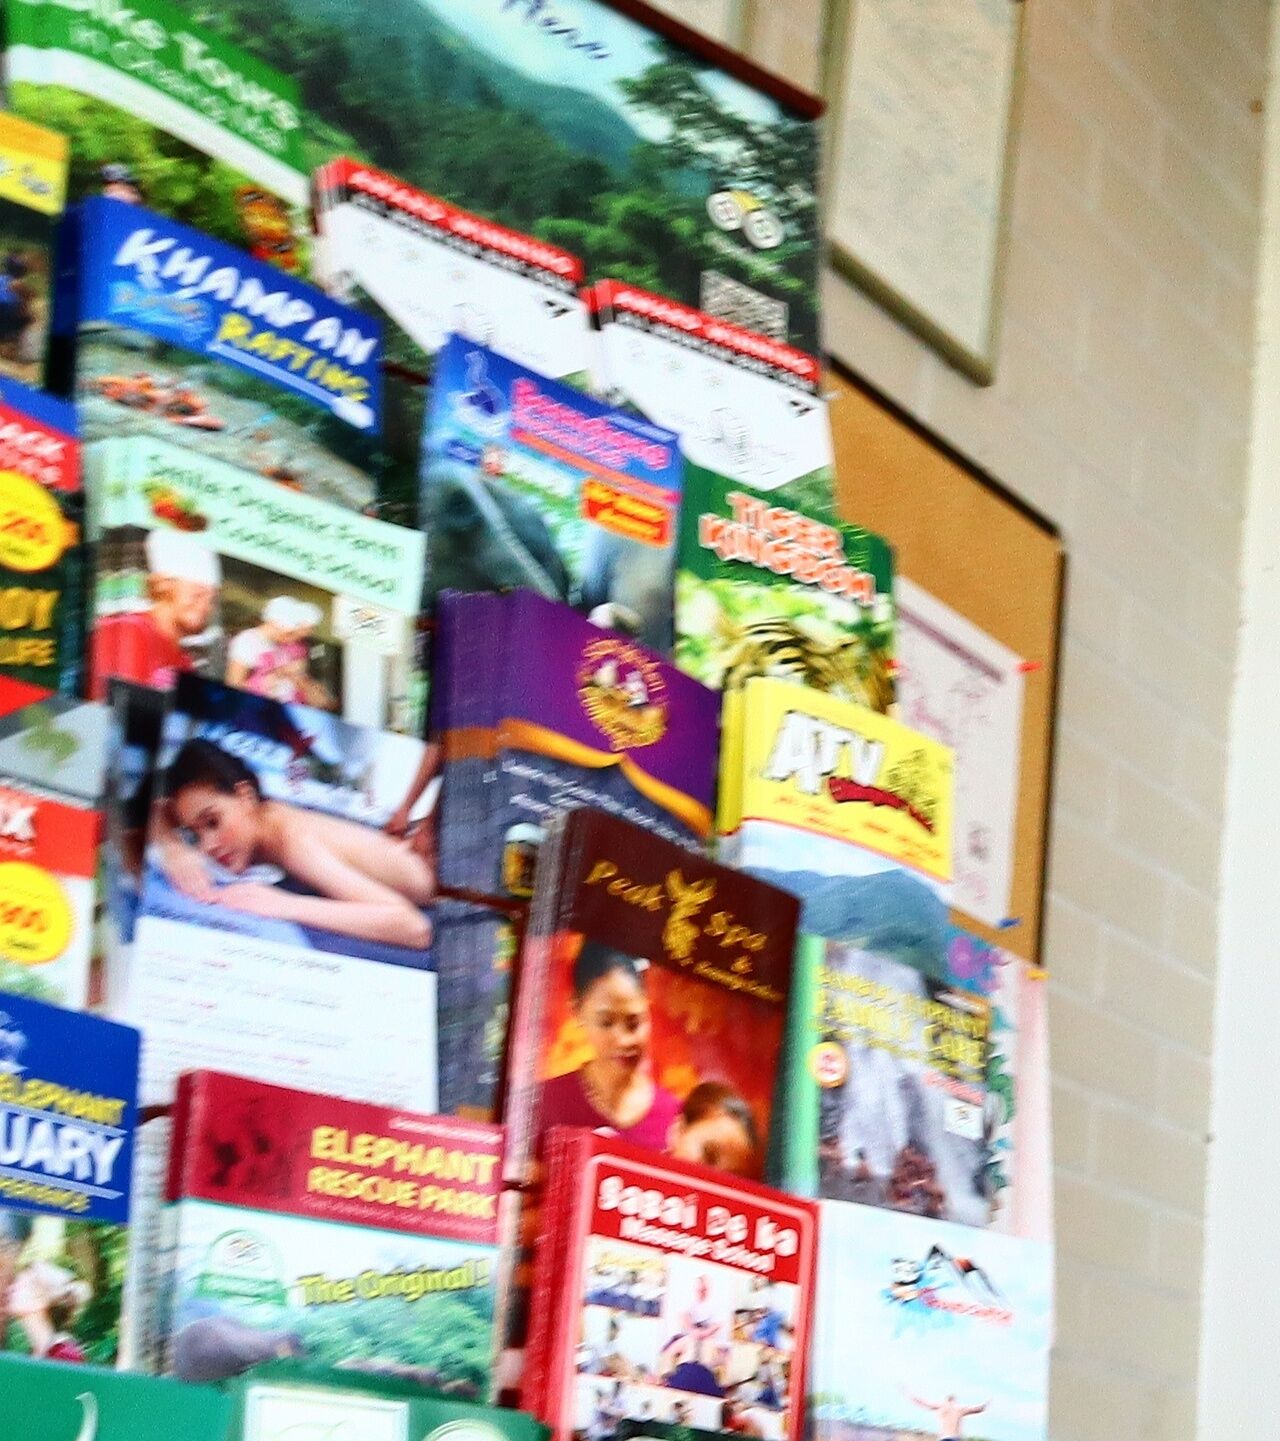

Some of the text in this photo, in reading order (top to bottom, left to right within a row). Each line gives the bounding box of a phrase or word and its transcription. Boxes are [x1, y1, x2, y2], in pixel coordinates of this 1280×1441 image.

[310, 1124, 501, 1186] ELEPHANT
[307, 1165, 420, 1209] RESCUE
[419, 1184, 498, 1221] PARK
[296, 1271, 357, 1307] The
